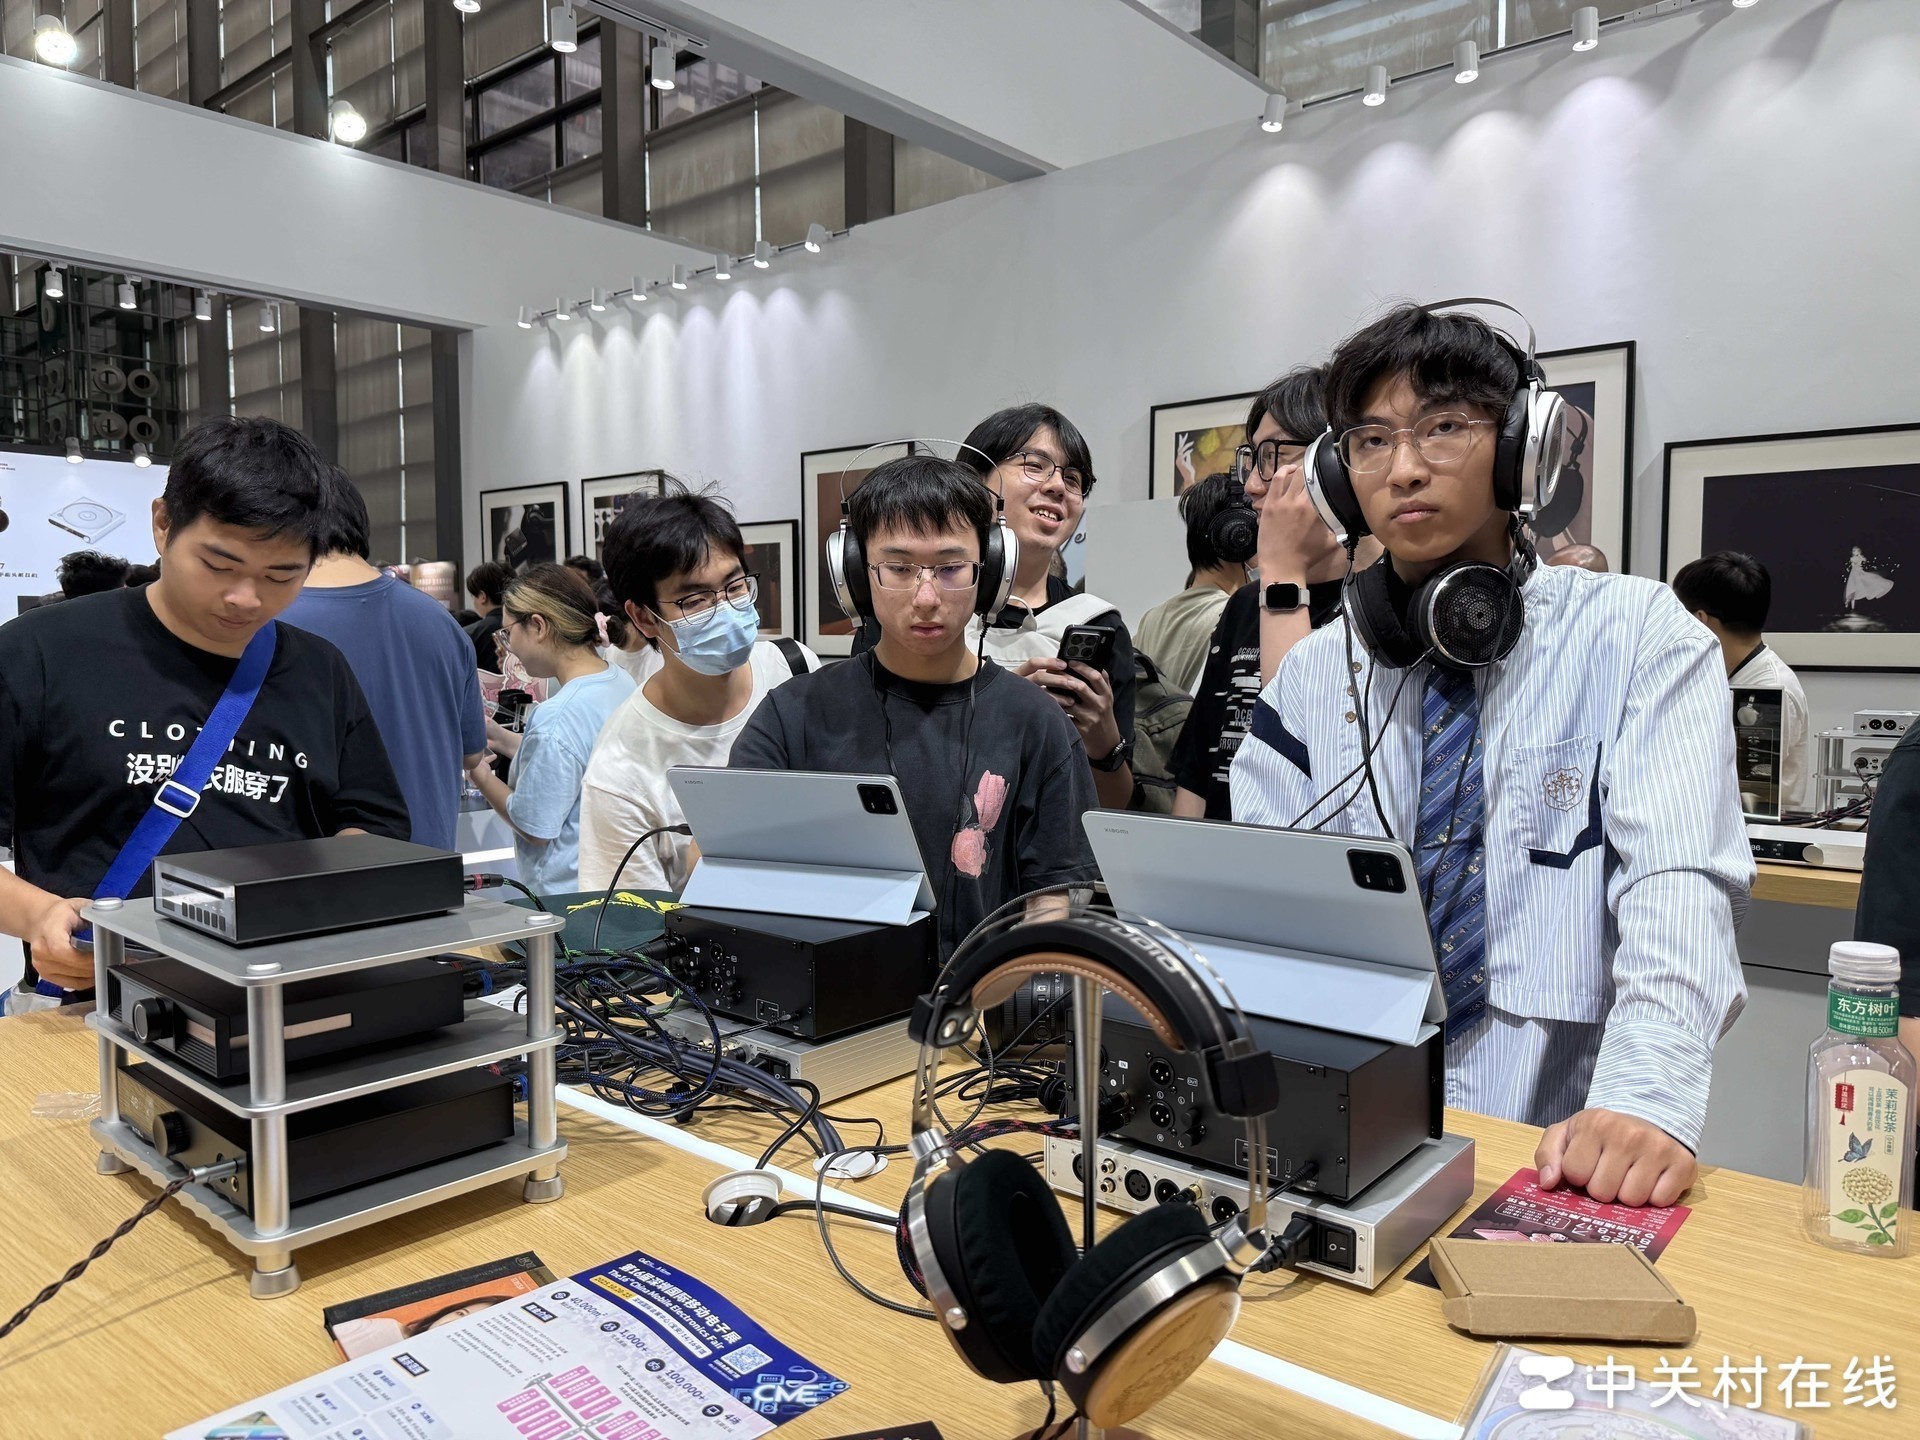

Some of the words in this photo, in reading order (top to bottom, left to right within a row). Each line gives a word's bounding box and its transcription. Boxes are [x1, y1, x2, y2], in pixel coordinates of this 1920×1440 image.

[109, 719, 308, 769] CLOING
[126, 752, 289, 803] 没别衣服穿了
[1837, 997, 1896, 1017] 东方树叶
[1884, 1088, 1898, 1133] 茉莉花茶
[618, 1263, 742, 1344] 第16届深圳国际移动电子展
[650, 1289, 673, 1308] Mobile
[670, 1304, 710, 1338] Electronics
[707, 1335, 725, 1349] Fair
[620, 1329, 648, 1351] 1,000+
[664, 1370, 705, 1400] 100,000+
[753, 1384, 821, 1403] CME
